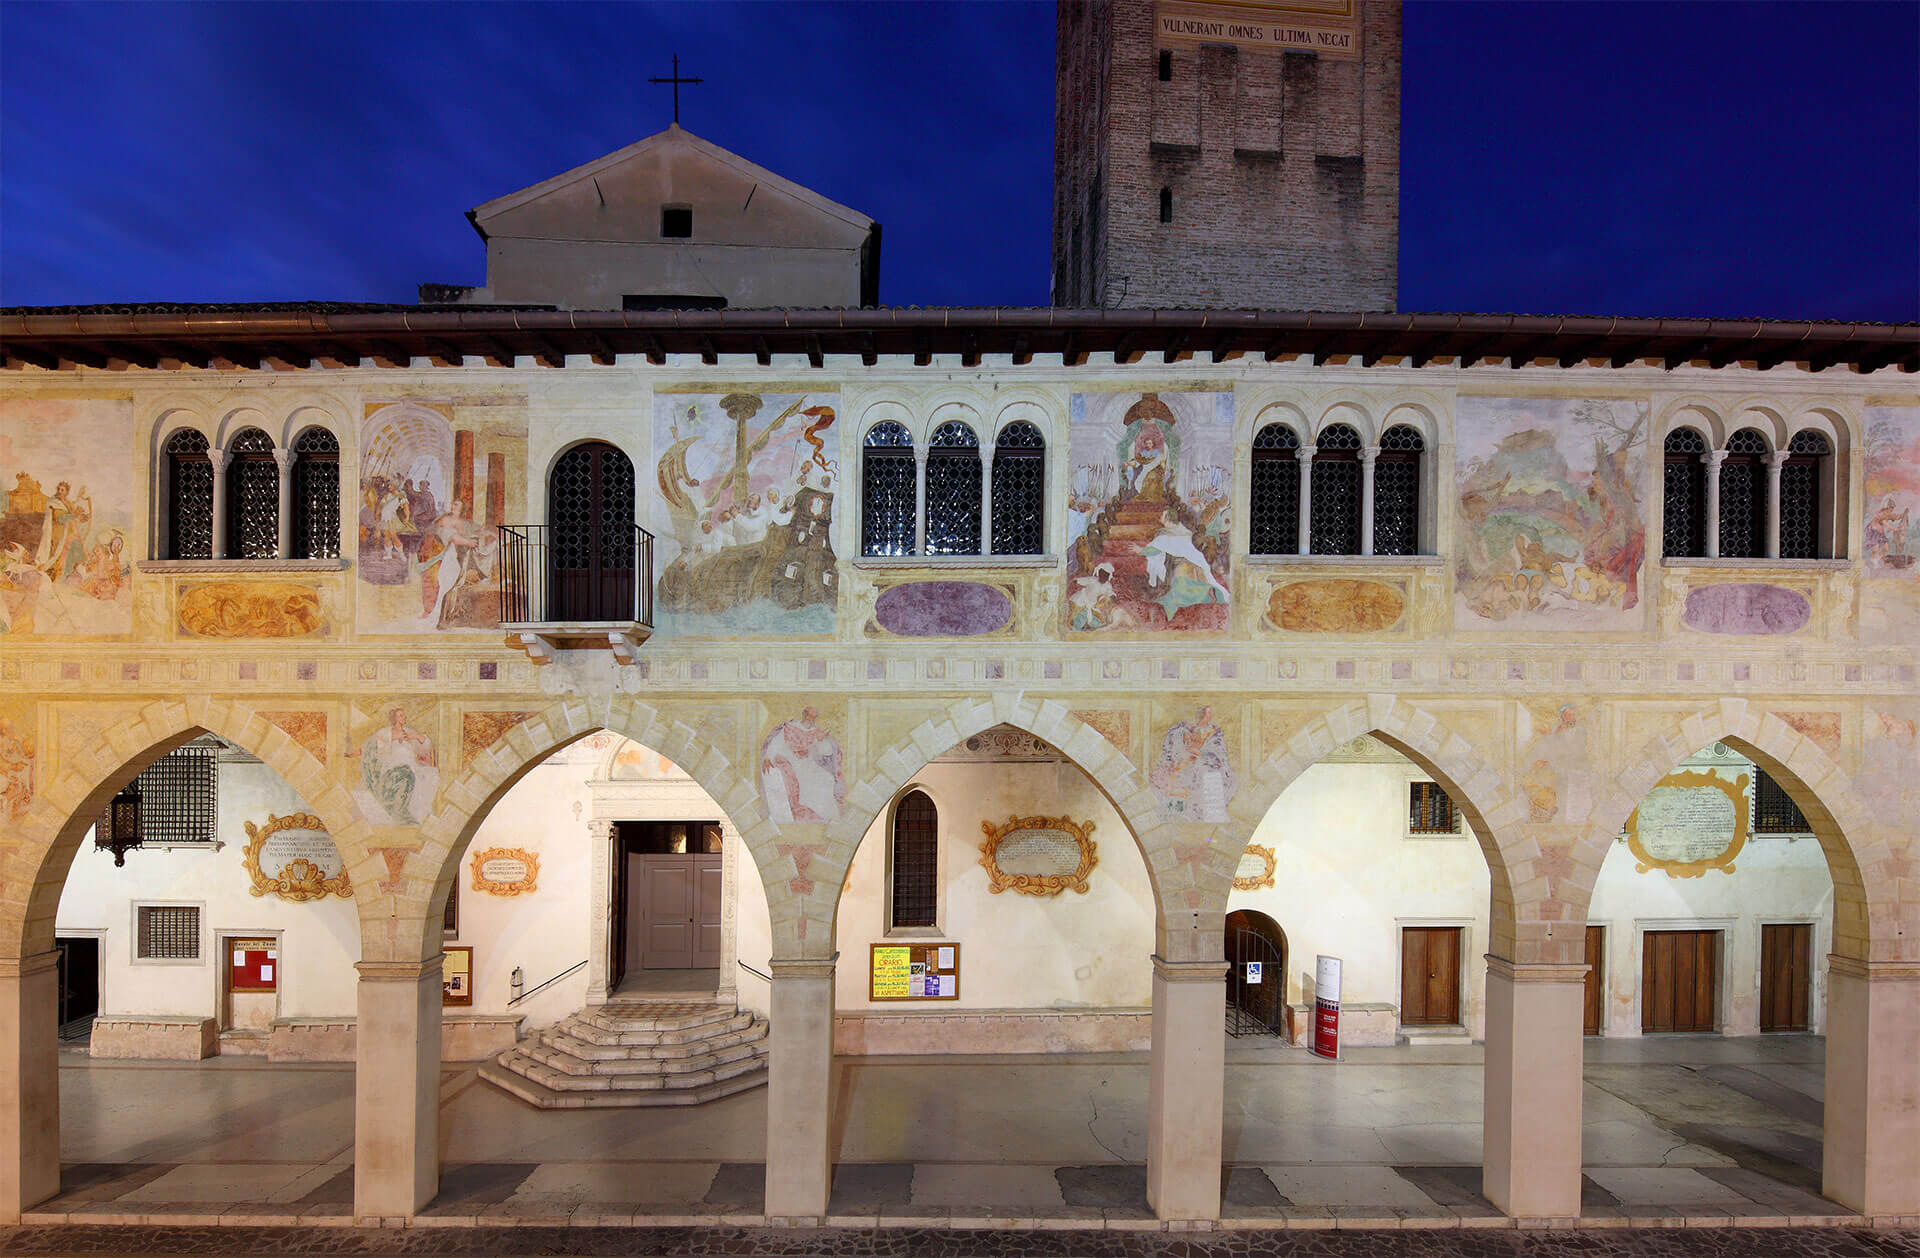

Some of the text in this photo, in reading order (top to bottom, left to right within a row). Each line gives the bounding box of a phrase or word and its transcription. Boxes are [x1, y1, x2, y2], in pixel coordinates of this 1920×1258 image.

[1163, 19, 1351, 47] VULNERANT OMNES ULTIMA NECAT
